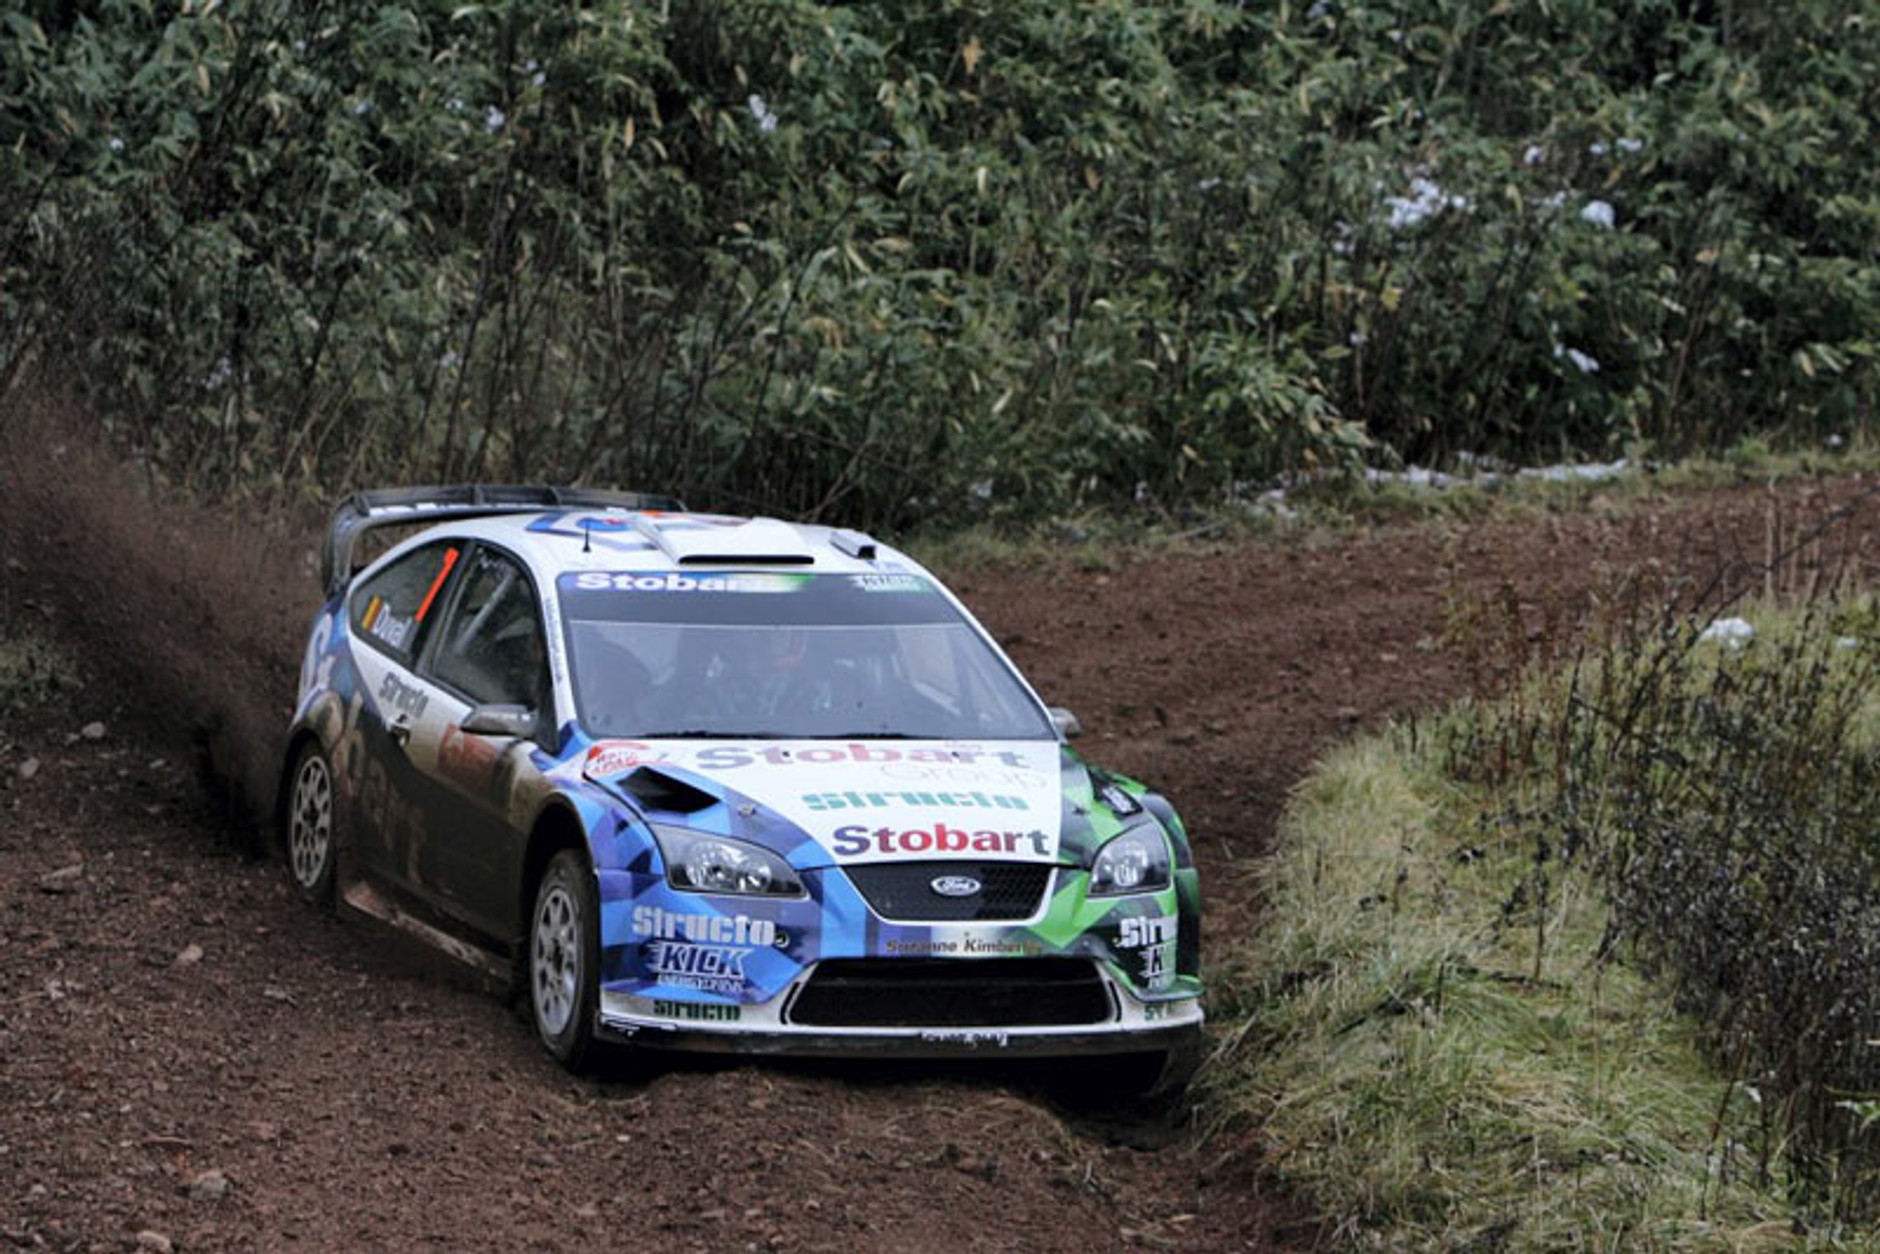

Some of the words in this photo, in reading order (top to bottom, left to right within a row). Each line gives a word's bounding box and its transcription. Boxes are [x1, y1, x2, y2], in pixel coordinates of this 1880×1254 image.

[576, 573, 768, 592] Stoba
[832, 823, 1051, 857] Stobart
[942, 879, 971, 893] Ford
[632, 904, 776, 946] Structo
[659, 943, 748, 979] KICK
